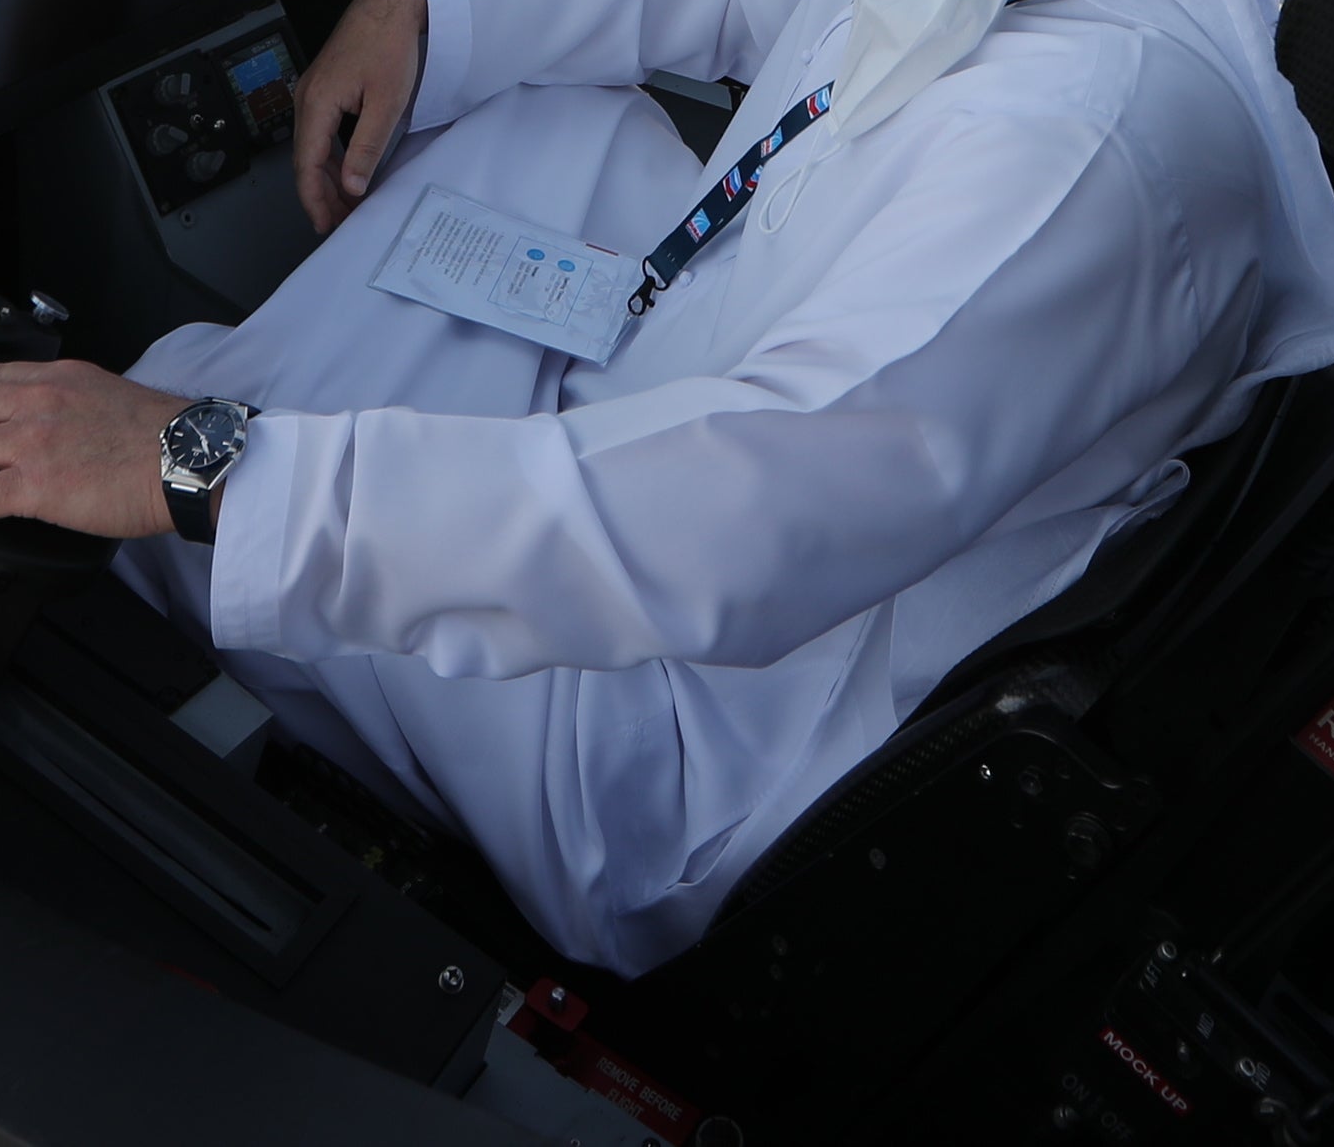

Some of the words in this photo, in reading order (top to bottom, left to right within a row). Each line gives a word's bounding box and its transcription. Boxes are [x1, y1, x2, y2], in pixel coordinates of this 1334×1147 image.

[596, 1056, 641, 1092] REMOVE
[639, 1085, 683, 1122] BEFORE
[606, 1088, 645, 1119] FLIGHT
[1103, 1031, 1160, 1088] MOCK
[1160, 1085, 1188, 1111] UP
